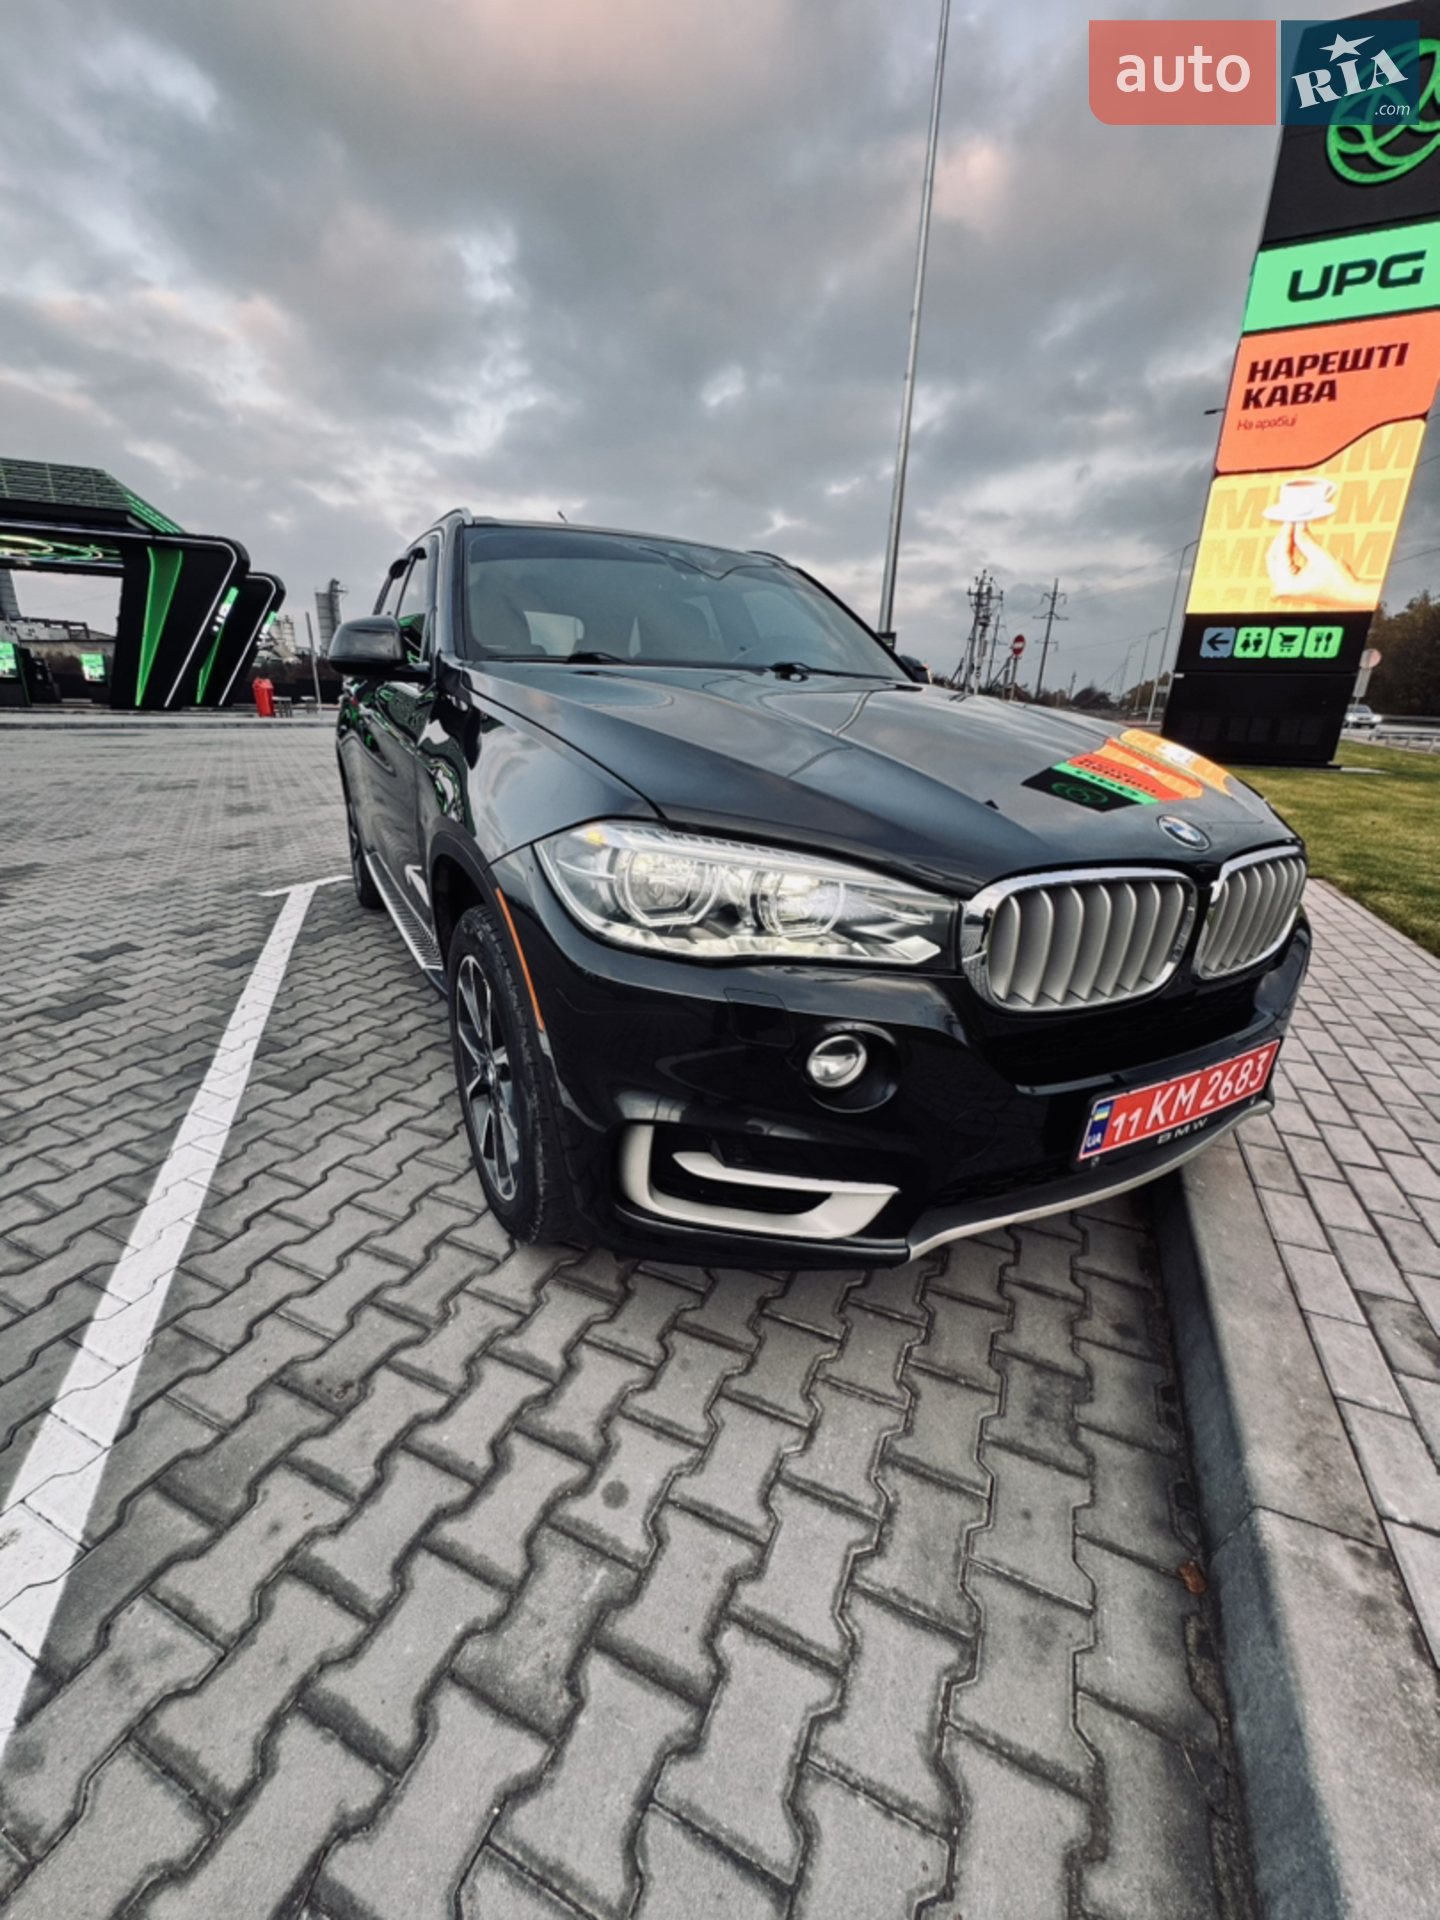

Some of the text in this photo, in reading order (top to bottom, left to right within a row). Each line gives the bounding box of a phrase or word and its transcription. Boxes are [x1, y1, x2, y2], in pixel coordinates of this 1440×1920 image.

[1287, 249, 1427, 303] UPG
[1246, 342, 1410, 384] НАРЕШТІ
[1241, 379, 1338, 411] КАВА
[1112, 1050, 1270, 1142] 11 KM 2683
[1157, 1117, 1209, 1145] BMW
